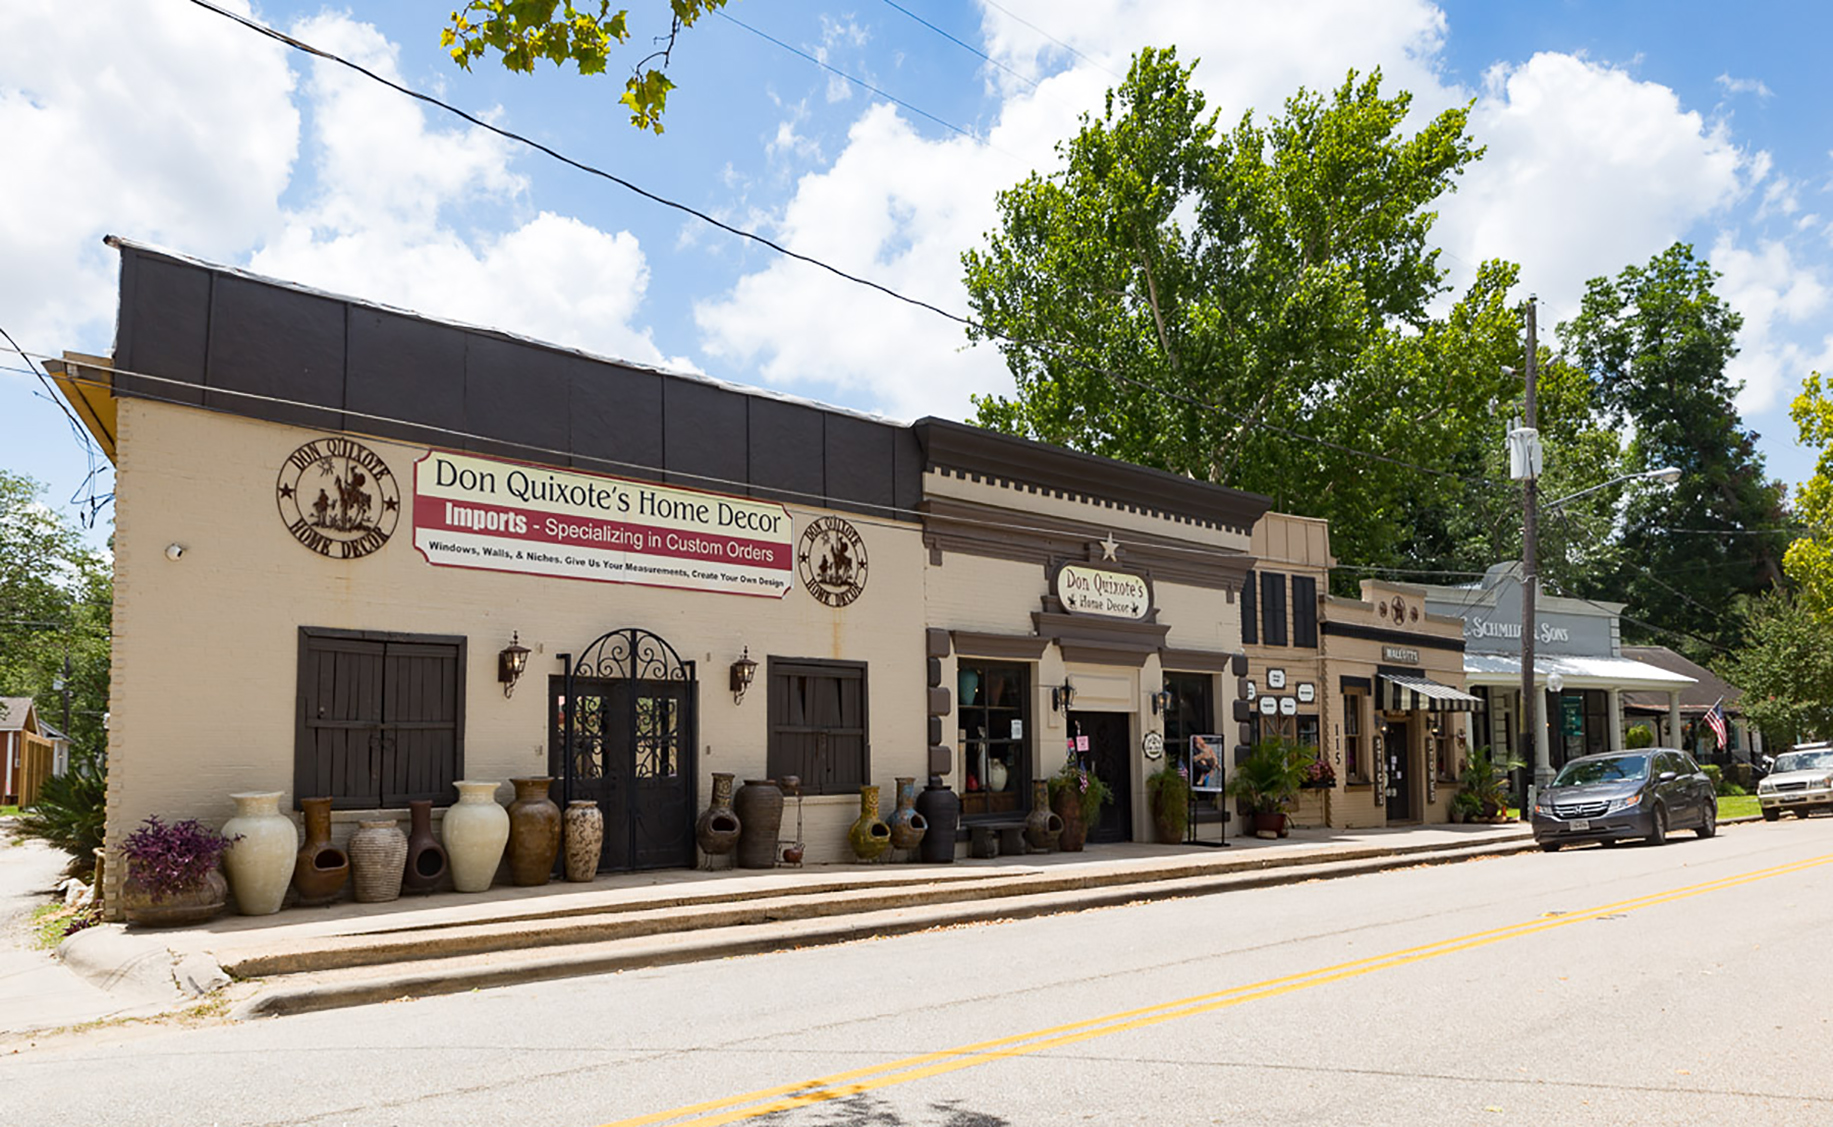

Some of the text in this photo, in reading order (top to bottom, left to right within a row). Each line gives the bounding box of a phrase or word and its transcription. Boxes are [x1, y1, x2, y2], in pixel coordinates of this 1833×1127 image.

[289, 439, 391, 481] DON QUIXOTE
[435, 458, 782, 533] Don Quixote's Home Decor
[289, 519, 390, 558] HOME DECOR
[445, 501, 527, 534] Imports
[544, 517, 643, 550] Specializing
[647, 530, 661, 548] in
[666, 533, 723, 556] Custom
[727, 541, 774, 562] Orders
[804, 520, 824, 543] DON
[428, 540, 480, 556] Windows,
[482, 546, 513, 560] Walls,
[515, 550, 524, 560] &
[564, 555, 586, 567] Give
[588, 558, 601, 569] Us
[602, 560, 623, 571] Your
[624, 563, 690, 578] Measurements,
[691, 569, 718, 581] Create
[720, 573, 738, 583] Your
[739, 575, 757, 585] Own
[758, 577, 784, 588] Design
[806, 577, 831, 605] HOME
[1066, 568, 1144, 598] Don Quixote's
[1080, 594, 1129, 613] Home Decor
[1472, 616, 1523, 638] SCHMID
